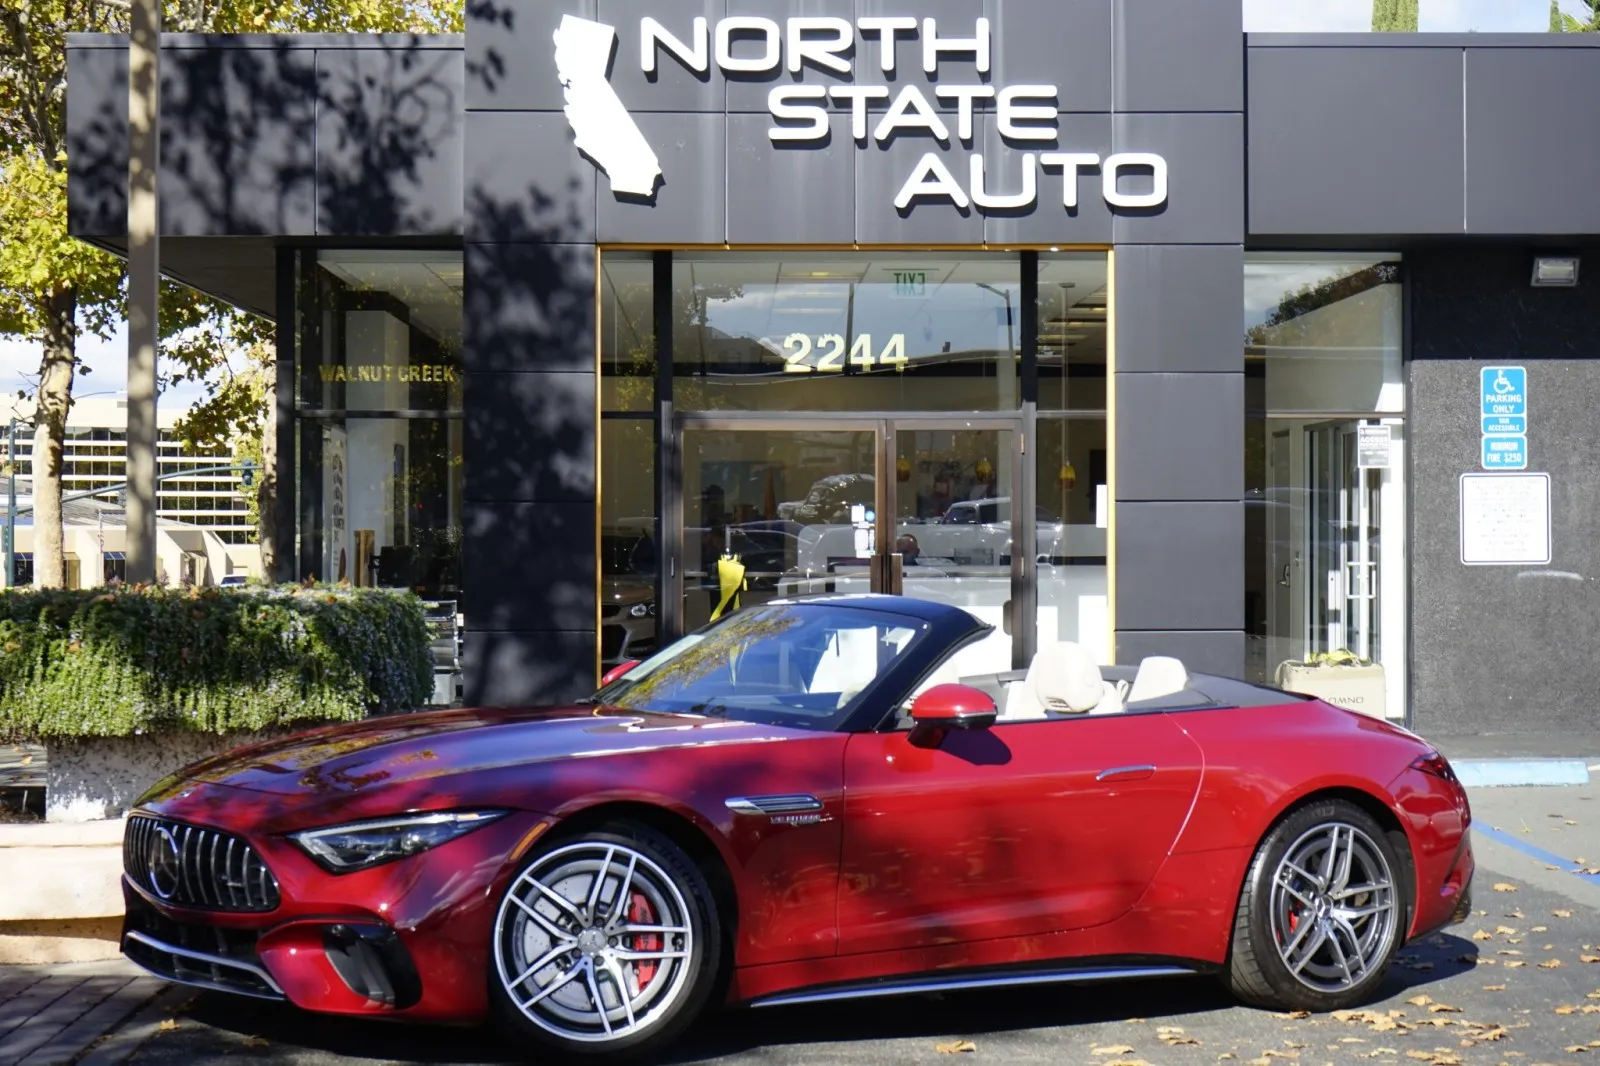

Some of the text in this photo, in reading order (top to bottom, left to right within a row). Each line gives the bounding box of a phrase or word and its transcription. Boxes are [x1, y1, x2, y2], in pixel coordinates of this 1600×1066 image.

[640, 16, 990, 73] NORTH
[767, 84, 1058, 141] STATE
[893, 152, 1168, 209] AUTO
[783, 332, 909, 372] 2244
[318, 364, 456, 382] WALNUT CREEK
[1485, 394, 1522, 403] PARKING
[1492, 404, 1515, 413] ONLY
